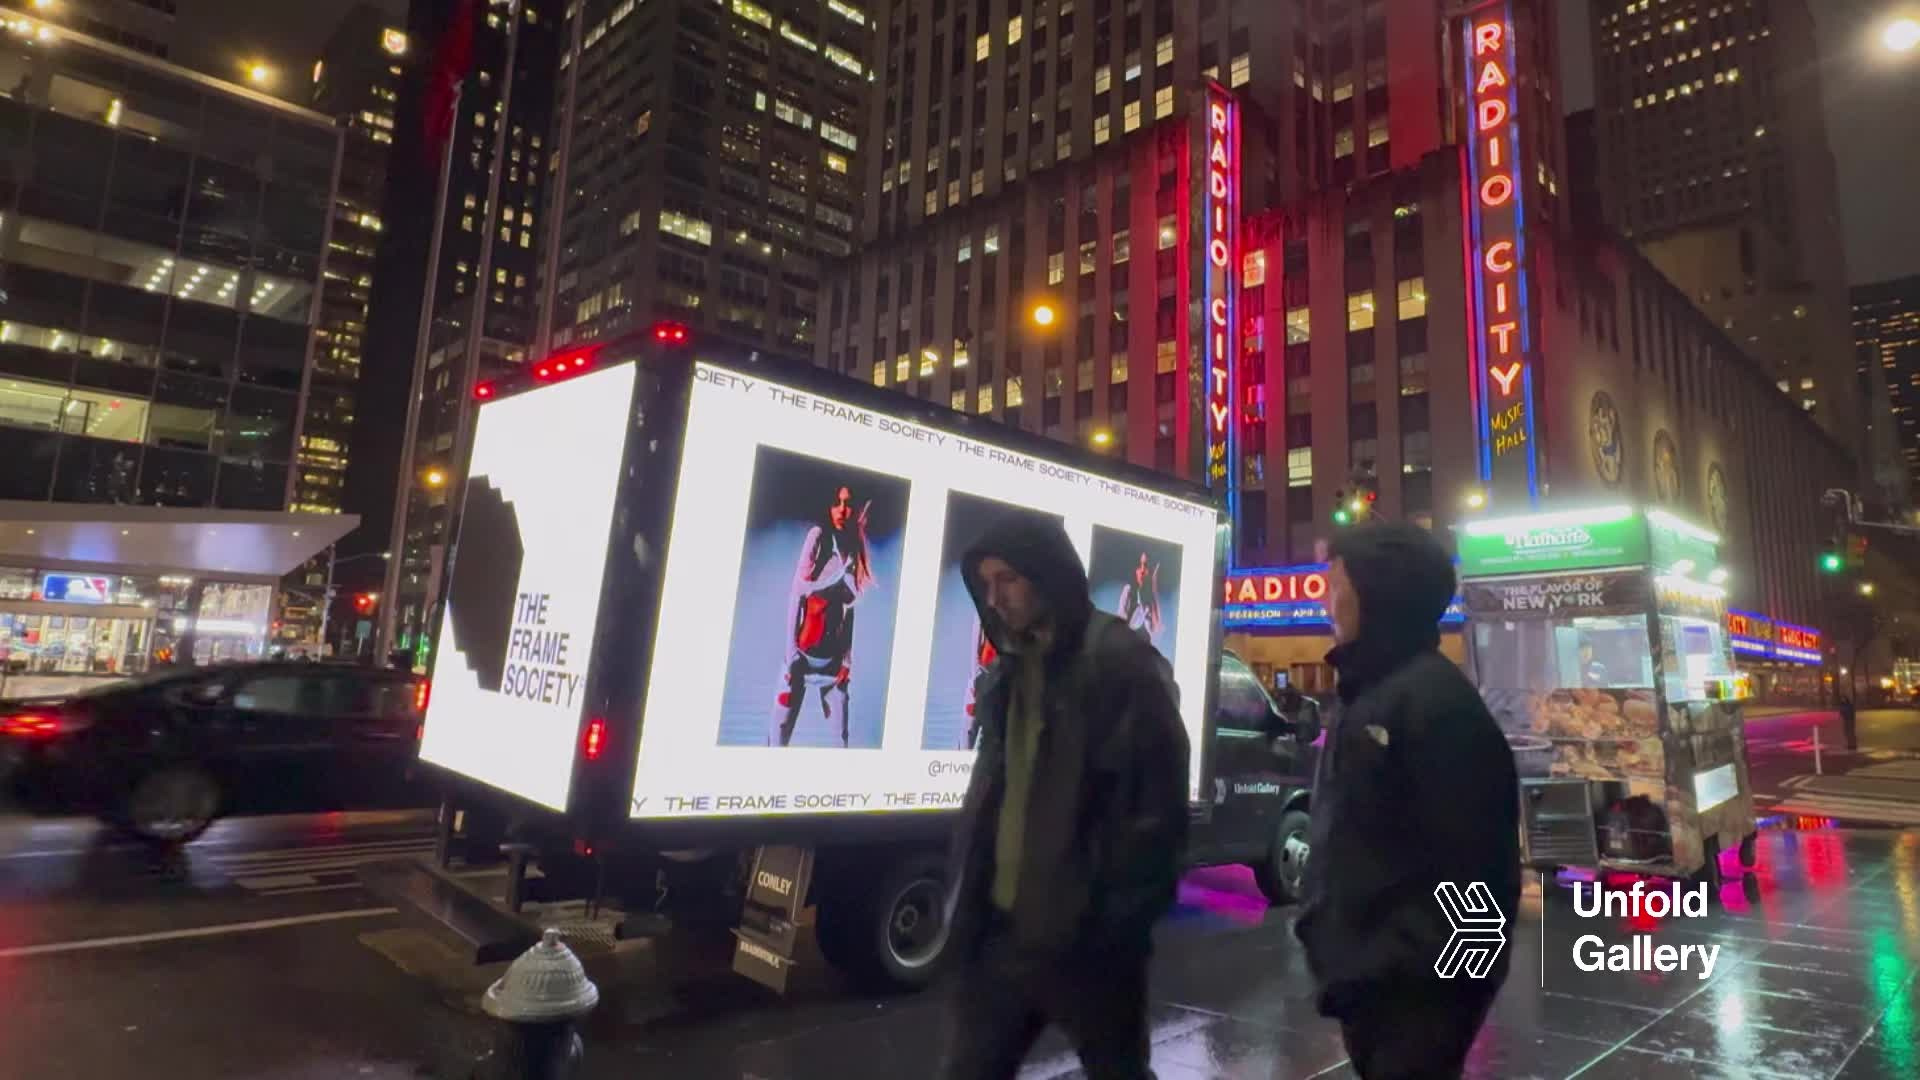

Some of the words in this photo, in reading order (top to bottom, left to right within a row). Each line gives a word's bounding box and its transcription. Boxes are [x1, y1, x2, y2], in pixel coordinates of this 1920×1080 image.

[1476, 22, 1512, 206] RADIO
[1210, 103, 1229, 268] RADIO
[1485, 241, 1521, 396] CITY
[1211, 298, 1229, 432] CITY
[694, 367, 755, 393] CIETY
[768, 386, 808, 409] THE
[812, 400, 873, 427] FRAME
[878, 418, 946, 447] SOCIETY
[956, 439, 985, 457] THE
[988, 450, 1035, 472] FRAME
[1039, 463, 1091, 486] SOCIETY
[1099, 480, 1122, 496] THE
[1124, 487, 1161, 506] FRAME
[1163, 498, 1205, 519] SOCIETY
[1503, 596, 1546, 611] NEW
[1504, 586, 1528, 596] THE
[1529, 583, 1582, 595] FLAVOR
[1584, 581, 1604, 592] OF
[517, 592, 550, 626] THE
[509, 628, 570, 666] FRAME
[927, 760, 970, 777] @rive
[664, 796, 711, 811] THE
[716, 794, 787, 810] FRAME
[793, 792, 872, 808] SOCIETY
[884, 792, 915, 806] THE
[921, 791, 966, 806] FRAM
[757, 871, 793, 896] CONLEY
